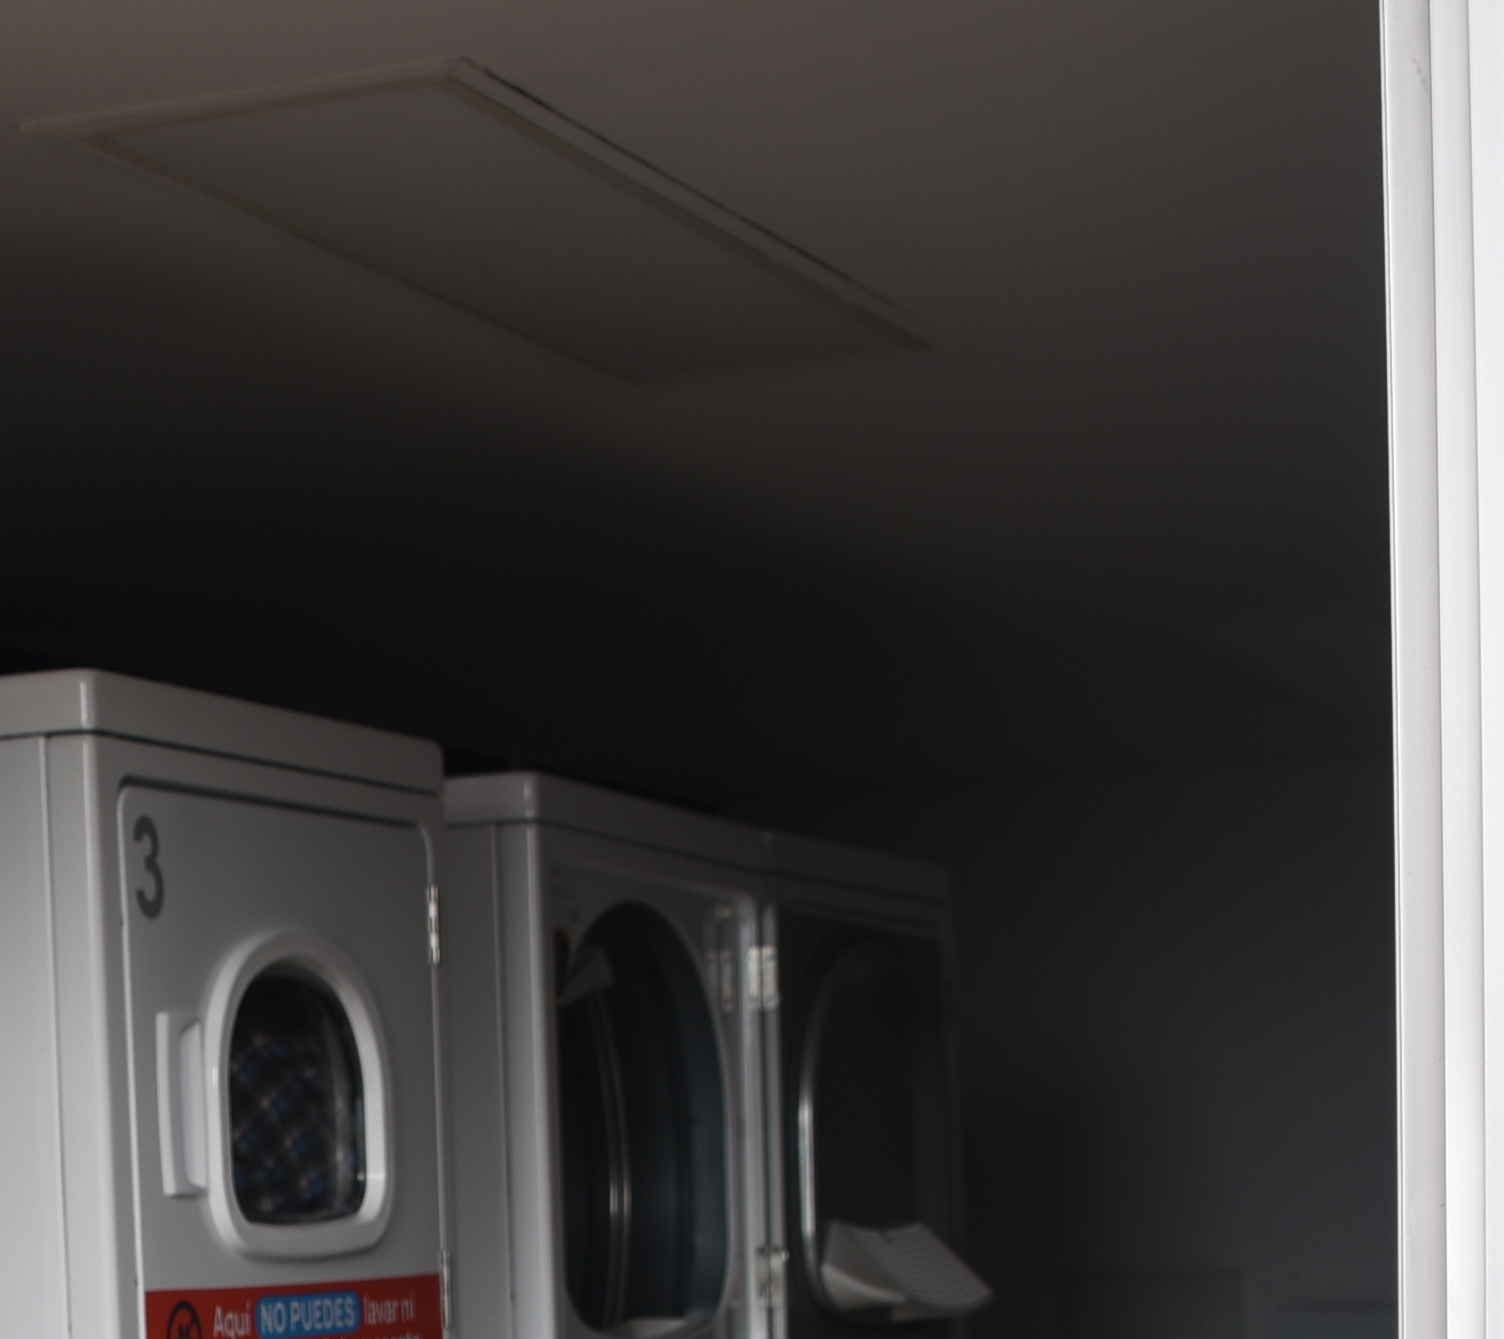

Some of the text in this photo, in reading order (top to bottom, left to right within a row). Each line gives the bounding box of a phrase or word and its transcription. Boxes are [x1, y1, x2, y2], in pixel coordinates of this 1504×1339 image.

[133, 815, 165, 920] 3
[259, 1303, 287, 1335] NO
[290, 1296, 358, 1333] PUEDES
[363, 1295, 398, 1328] lavar
